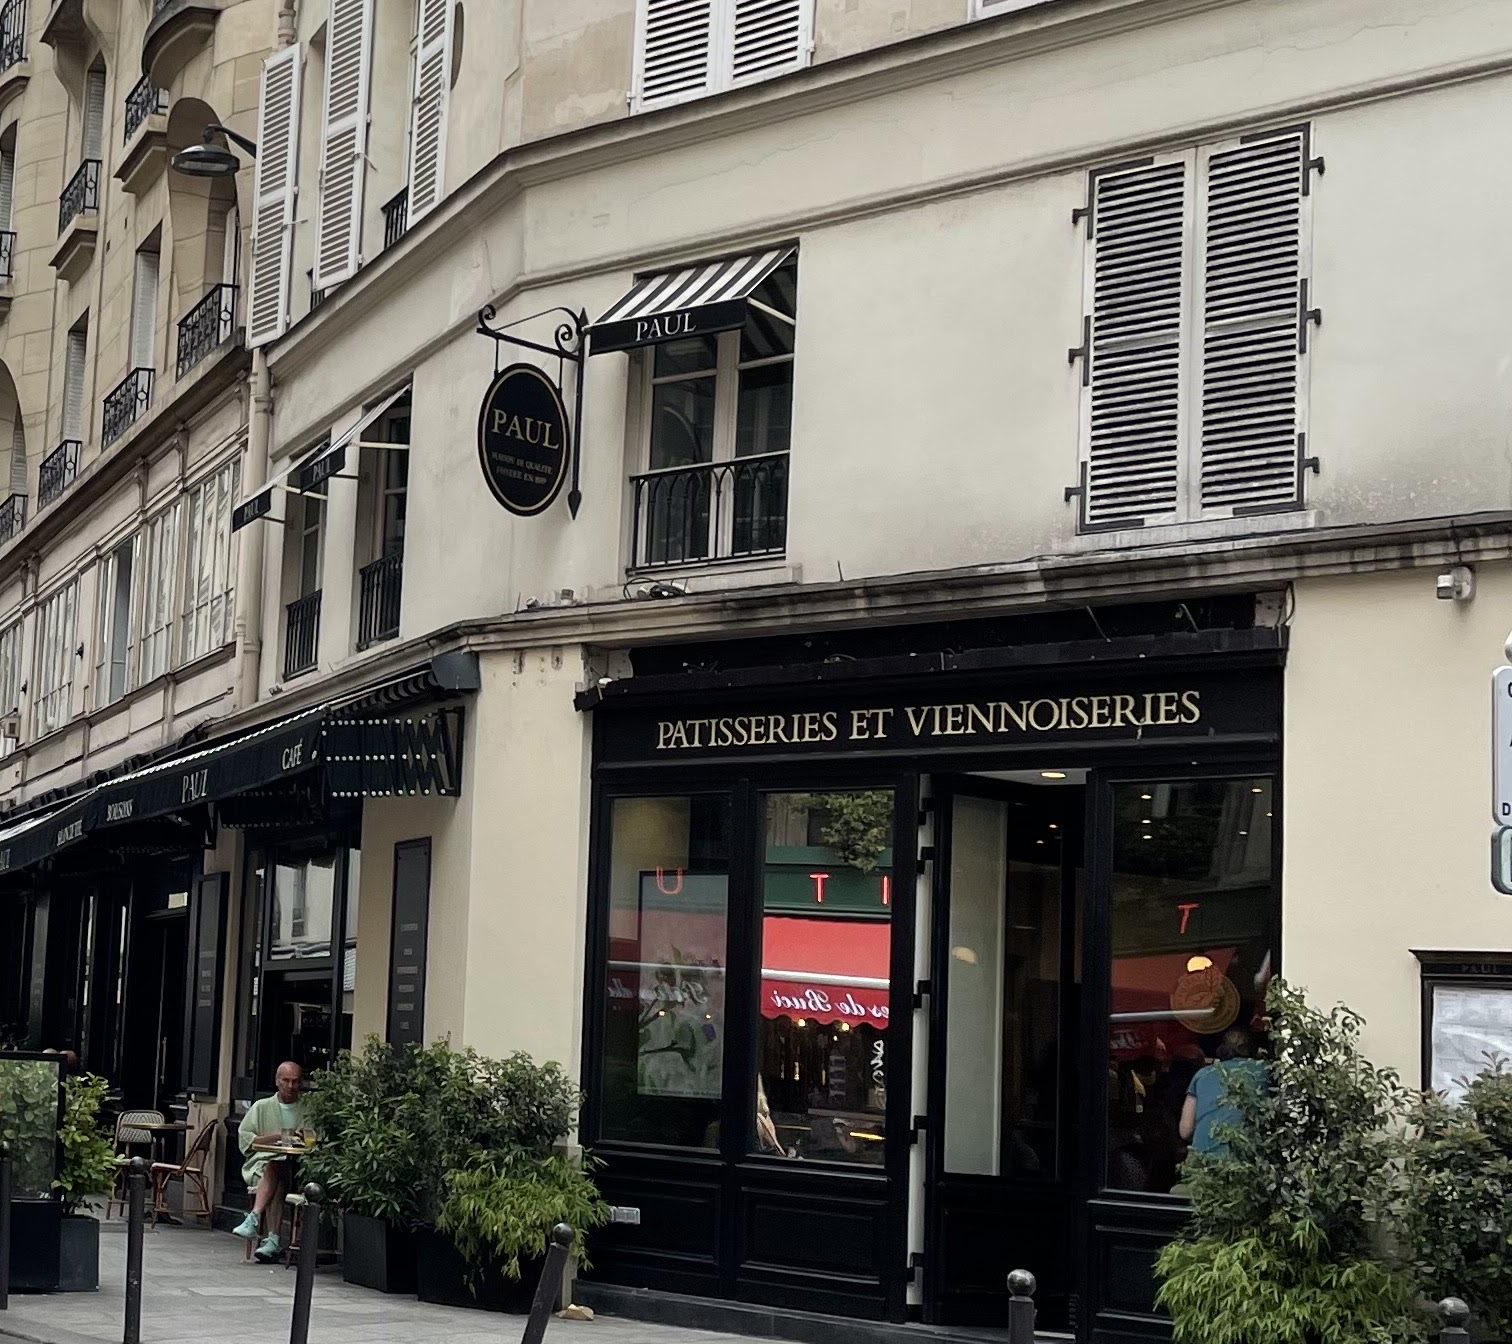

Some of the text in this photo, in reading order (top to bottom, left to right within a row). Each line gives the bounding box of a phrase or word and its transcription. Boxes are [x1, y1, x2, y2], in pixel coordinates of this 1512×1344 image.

[635, 312, 697, 342] PAUL
[491, 408, 560, 450] PAUL
[656, 690, 1202, 750] PATISSERIES ET VIENNOISERIES
